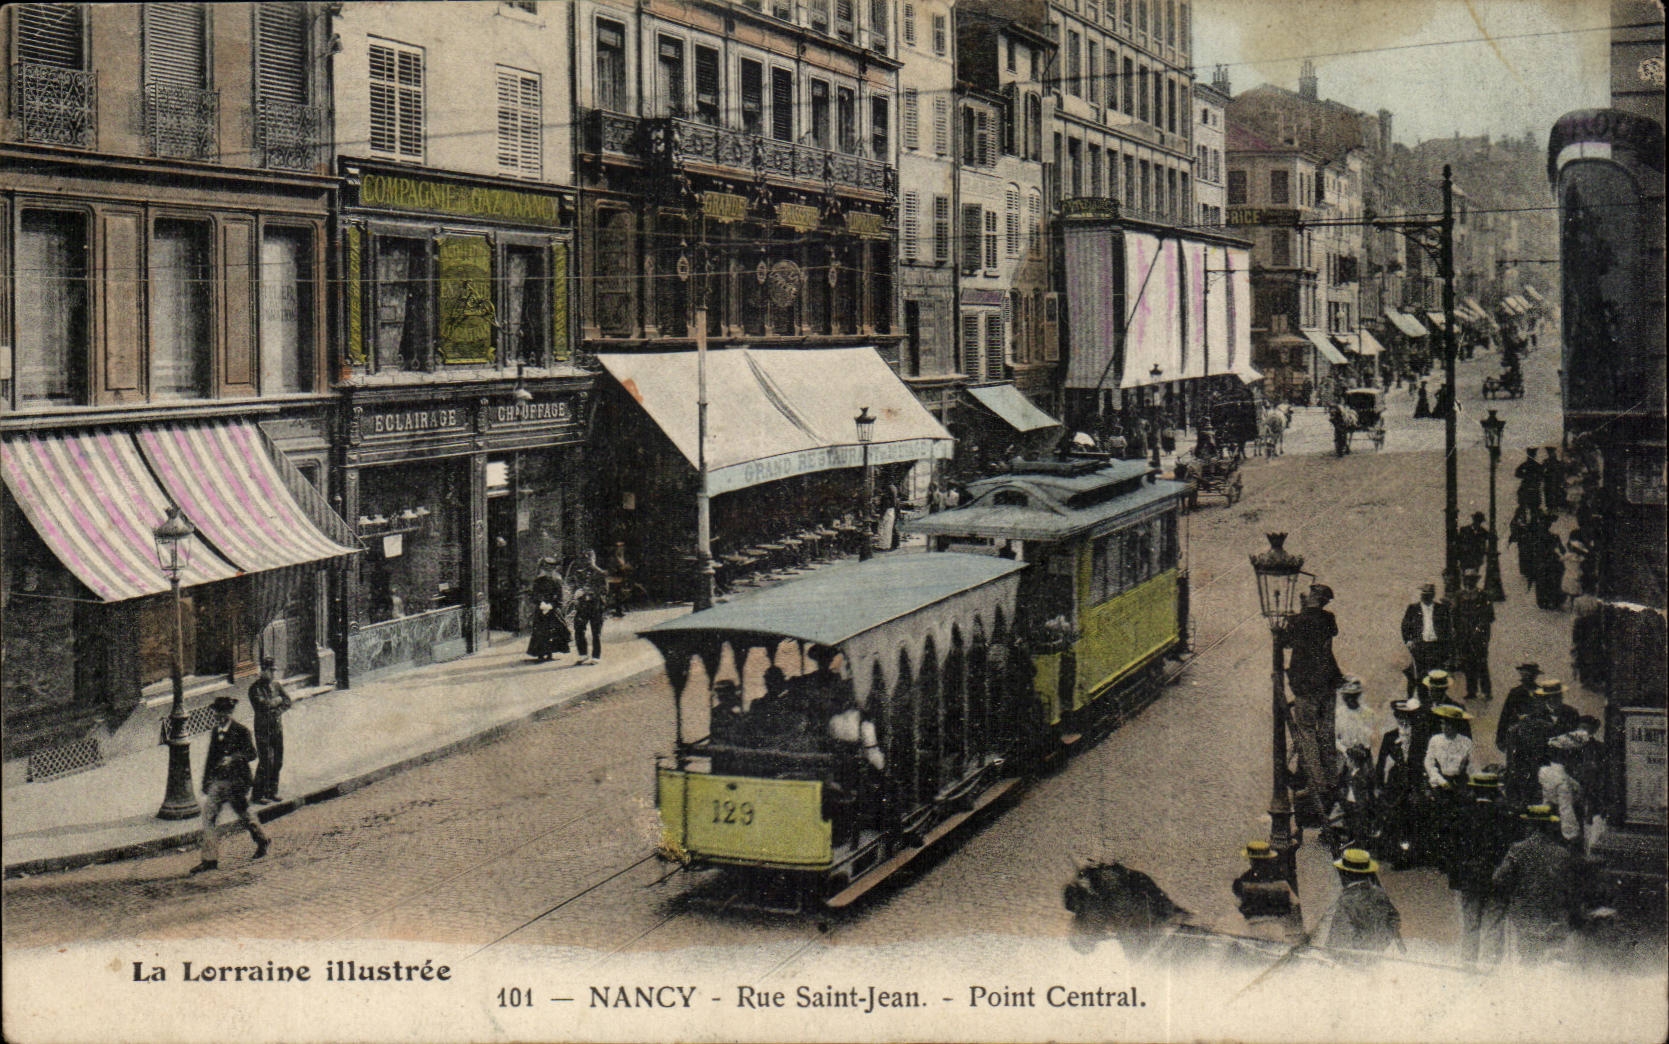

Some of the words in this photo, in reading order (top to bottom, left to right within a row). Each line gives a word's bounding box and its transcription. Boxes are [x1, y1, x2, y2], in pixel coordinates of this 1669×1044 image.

[363, 174, 456, 211] COMPAGNIE
[471, 187, 502, 215] GAZ
[513, 192, 559, 219] NANCY
[705, 193, 747, 217] GRANDE
[374, 408, 457, 433] ECLAIRAGE
[497, 402, 566, 422] CHAUFFAGE
[744, 457, 791, 482] GRAND
[712, 799, 755, 826] 129
